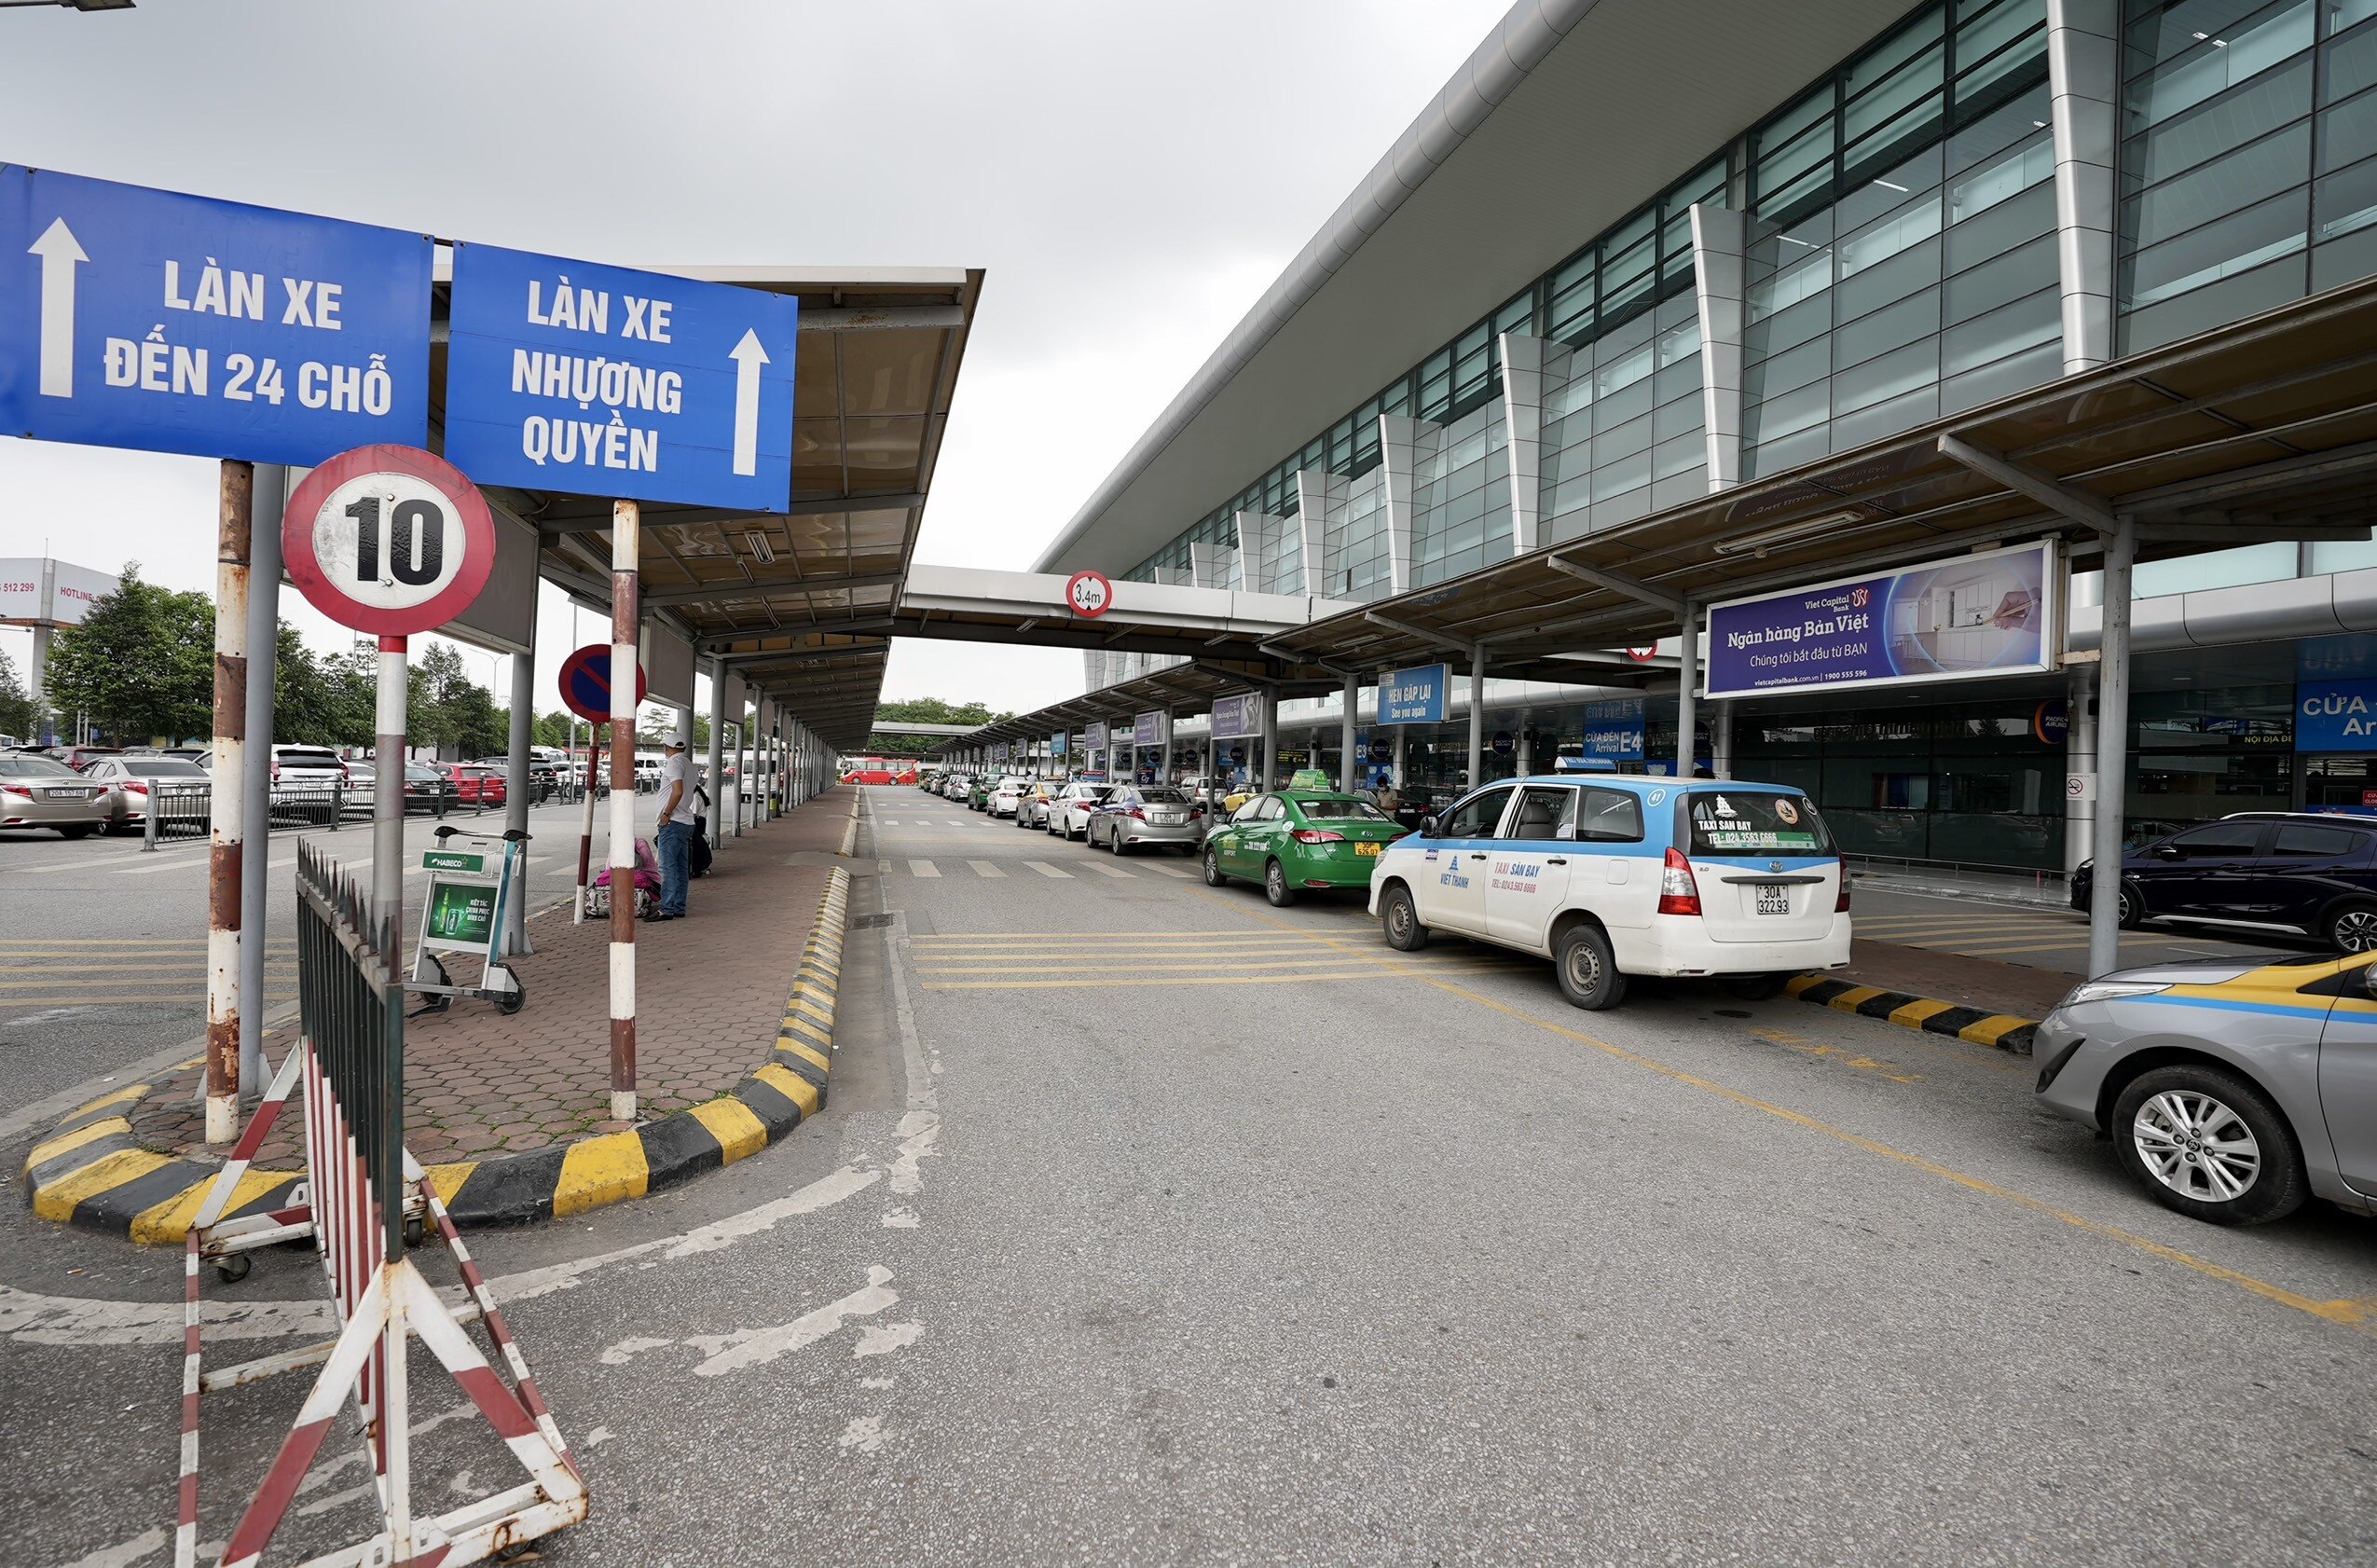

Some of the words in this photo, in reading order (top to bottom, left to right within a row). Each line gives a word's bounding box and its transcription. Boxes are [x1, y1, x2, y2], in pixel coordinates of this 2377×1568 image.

[164, 255, 264, 321] LÀN
[282, 277, 343, 331] XE
[528, 274, 609, 335] LÀN
[621, 295, 673, 344] XE
[103, 323, 208, 397] ĐẾN
[224, 353, 285, 406] 24
[297, 352, 392, 416] CHỖ
[522, 408, 658, 473] QUYỀN
[345, 497, 444, 585] 10
[4, 583, 18, 593] 512
[20, 583, 35, 592] 299
[1076, 584, 1101, 603] 3.4m
[1805, 601, 1820, 610] Viet
[1821, 595, 1849, 608] Capital
[1727, 630, 1763, 650] Ngân
[1765, 626, 1801, 642] hàng
[1804, 619, 1834, 637] Bản
[1836, 612, 1869, 633] Việt
[1750, 654, 1777, 667] Chúng
[1779, 652, 1792, 664] tôi
[1793, 649, 1809, 663] bắt
[1811, 647, 1829, 660] đầu
[1832, 645, 1843, 658] từ
[1844, 642, 1868, 657] BẠN
[1754, 675, 1819, 687] vietcapitalbank.com.vn
[1388, 688, 1402, 706] HẸN
[1404, 684, 1418, 705] GẶP
[1420, 684, 1431, 703] LẠI
[1392, 708, 1401, 719] See
[1401, 708, 1410, 719] you
[1411, 706, 1426, 718] again
[2302, 693, 2369, 716] CỬA
[1595, 742, 1619, 752] Arrival
[1620, 730, 1642, 752] E4
[1651, 793, 1661, 802] 41
[1698, 820, 1716, 831] TAXI
[1737, 821, 1752, 831] BAY
[436, 860, 462, 868] HABECO
[1494, 861, 1510, 874] TAXI
[1525, 864, 1541, 878] BAY
[1764, 886, 1781, 899] 30A
[1758, 900, 1788, 913] 322.93
